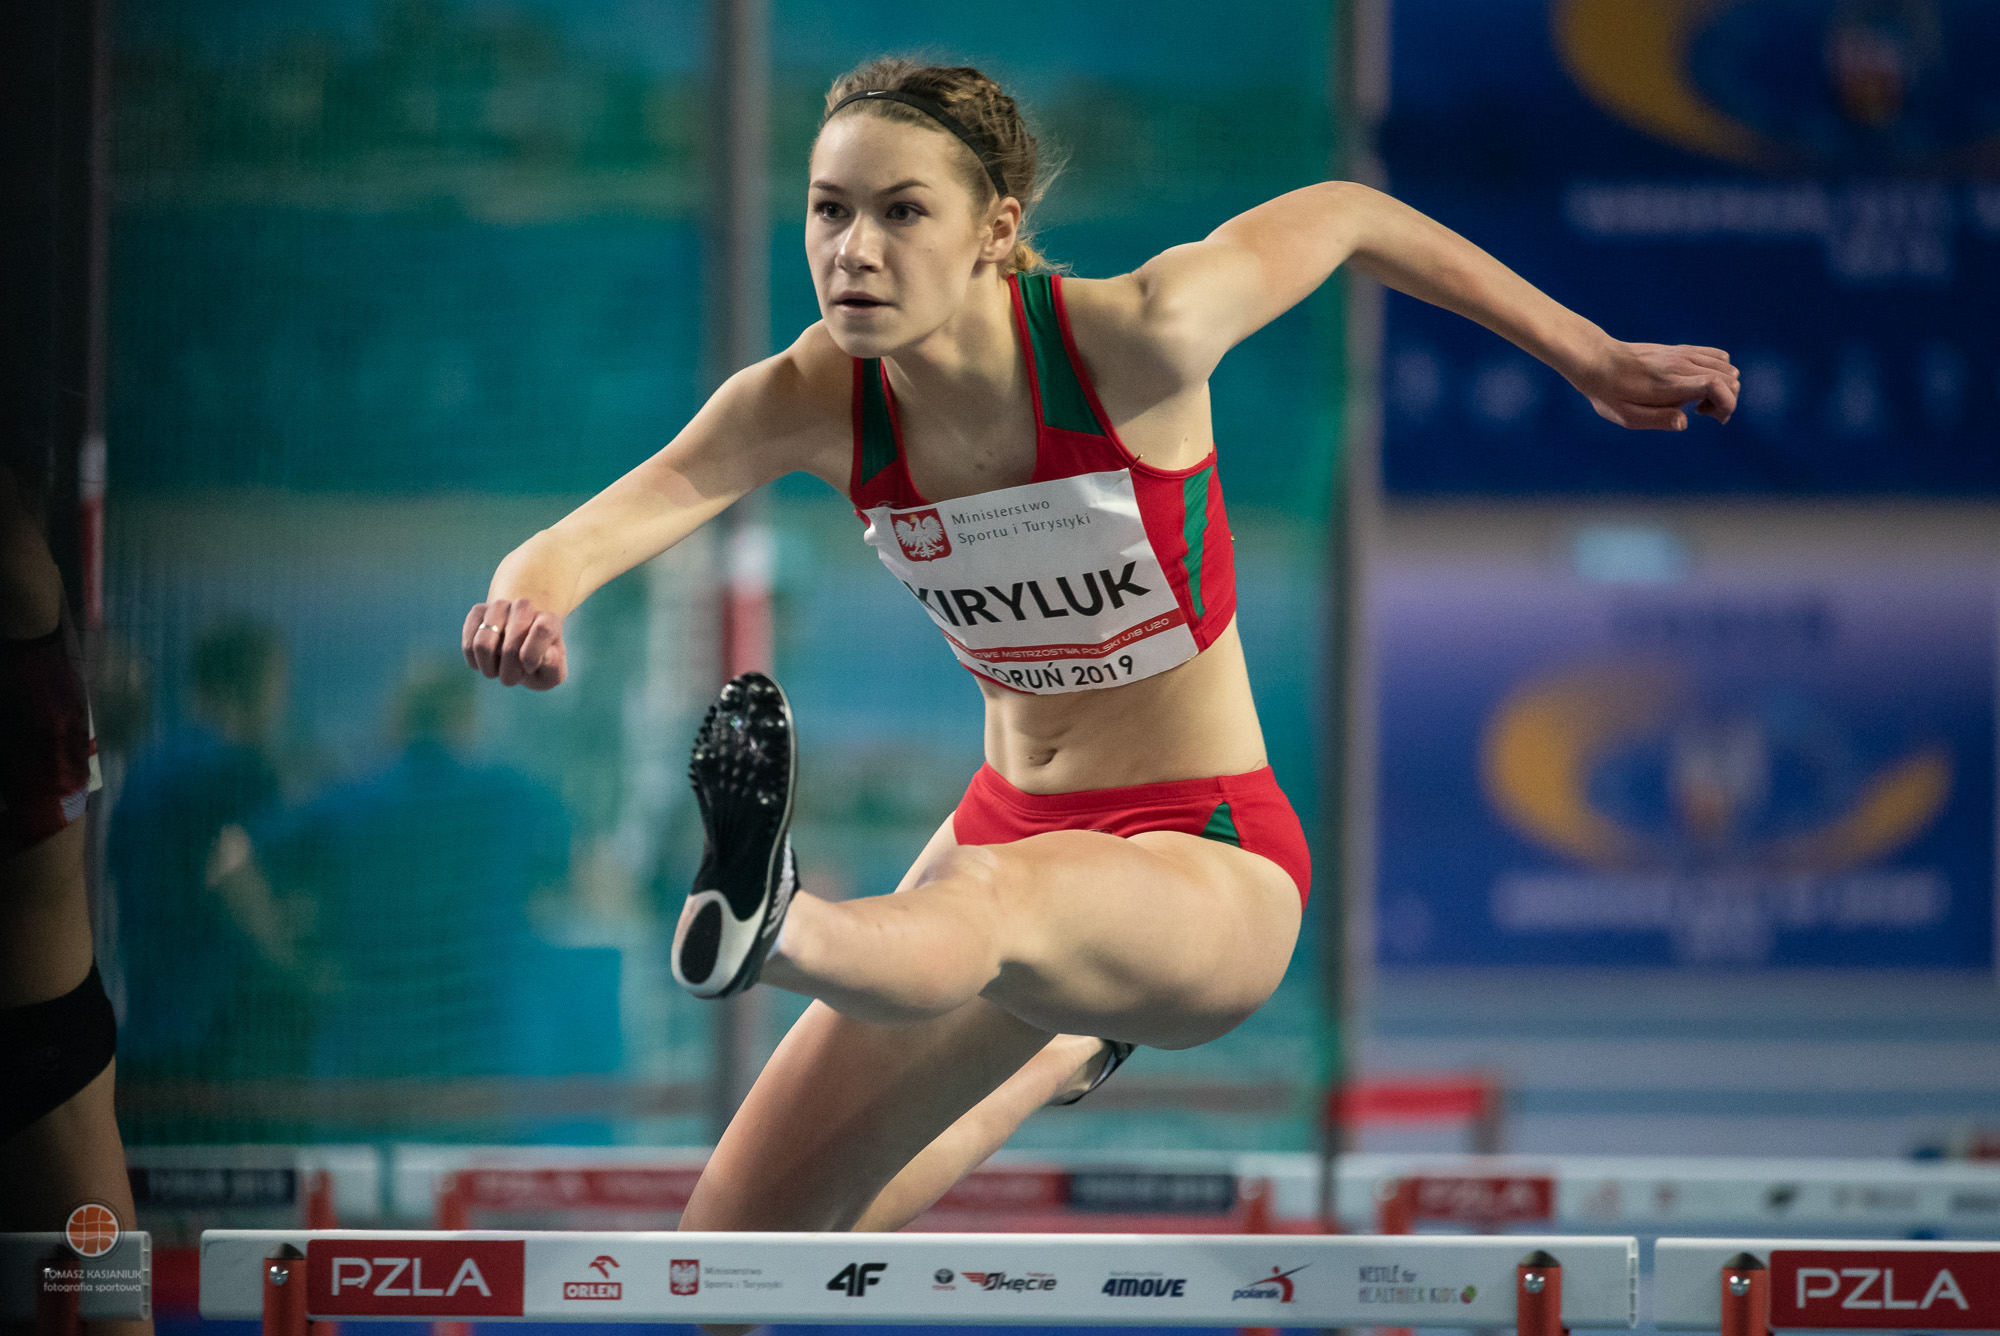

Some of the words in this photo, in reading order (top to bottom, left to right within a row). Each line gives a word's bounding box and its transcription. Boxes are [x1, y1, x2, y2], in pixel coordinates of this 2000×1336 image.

[951, 500, 1050, 525] Ministerstwo
[958, 528, 1008, 545] Sportu
[1012, 523, 1019, 535] i
[1022, 512, 1091, 533] Turystyki
[1001, 647, 1081, 659] MISTRZOSTWA
[1081, 639, 1121, 656] POLSKI
[1122, 628, 1144, 642] U18
[1144, 618, 1170, 632] U20
[979, 662, 1066, 689] TORUŃ
[1071, 655, 1134, 686] 2019
[331, 1257, 492, 1297] PZLA
[566, 1284, 620, 1298] ORLEN
[826, 1262, 889, 1297] 4F
[1102, 1278, 1188, 1297] 4MOVE
[1796, 1268, 1970, 1309] PZLA
